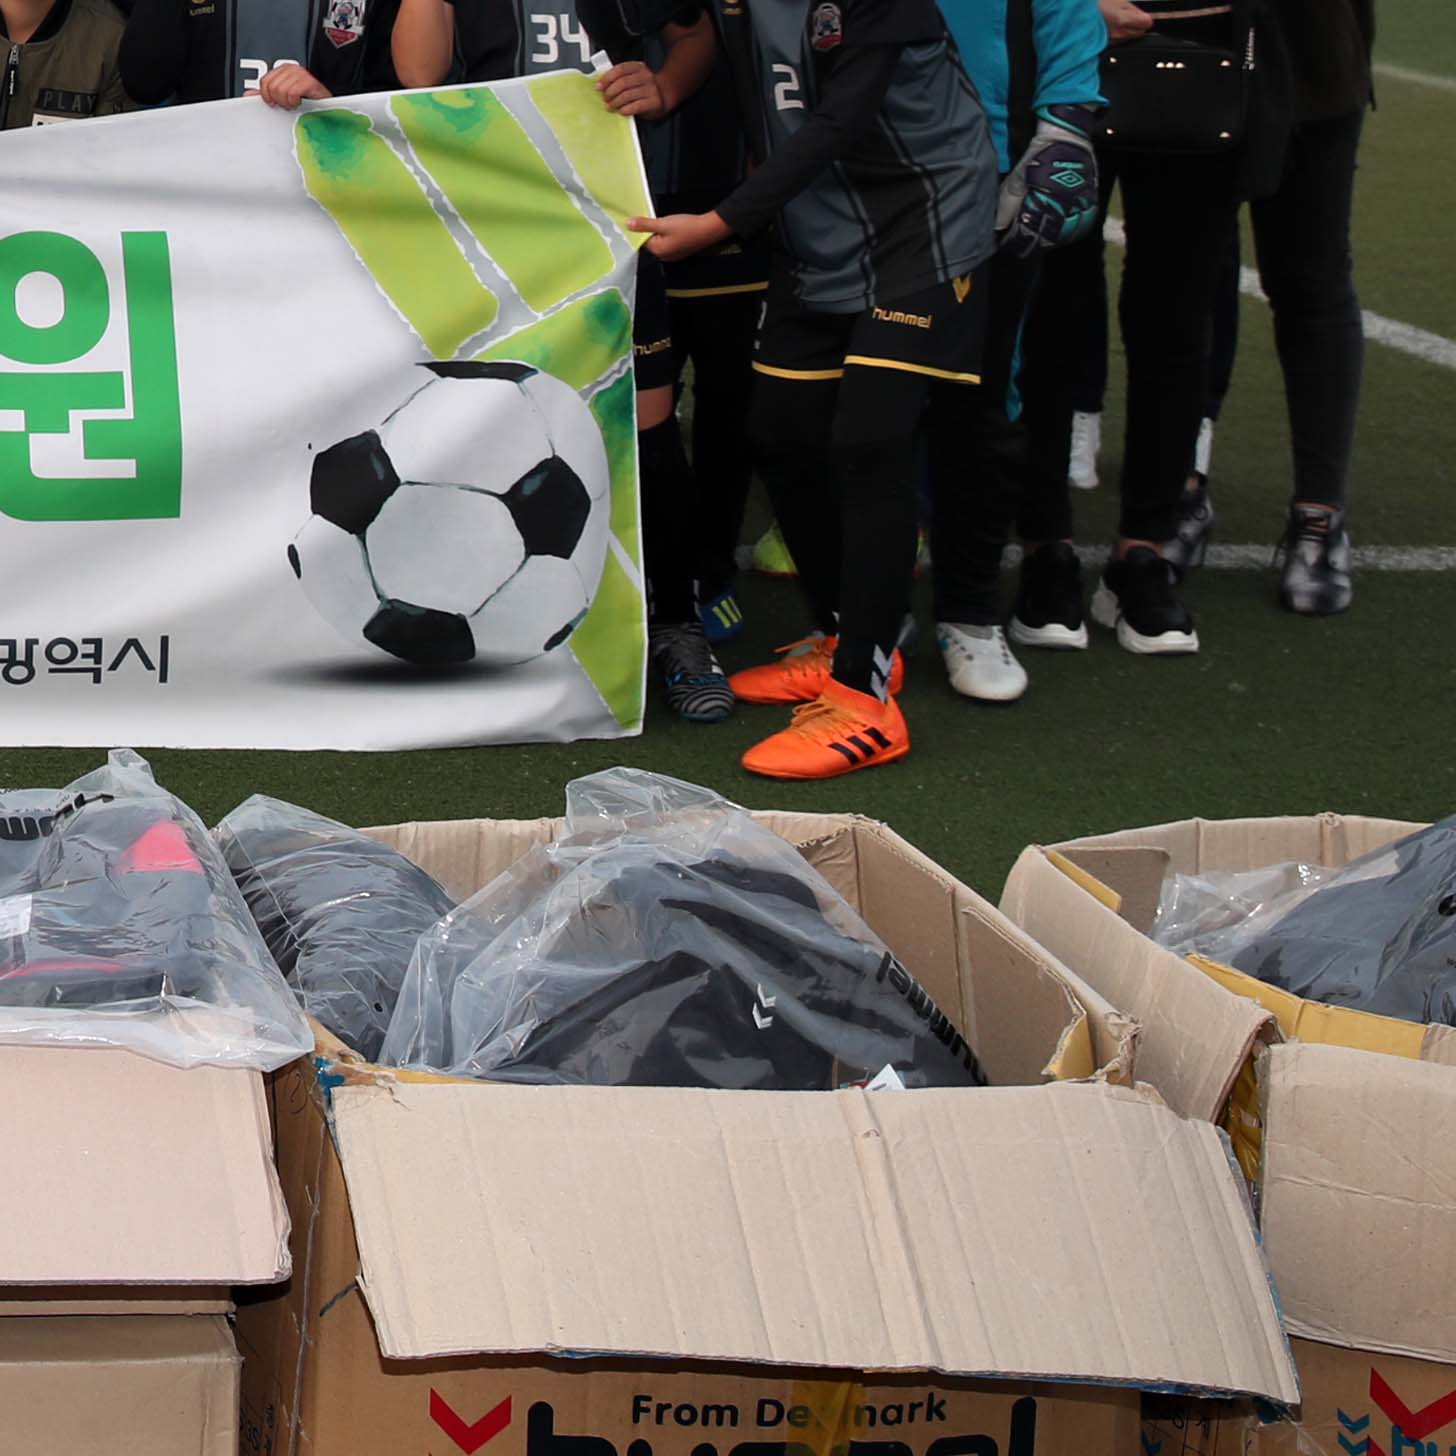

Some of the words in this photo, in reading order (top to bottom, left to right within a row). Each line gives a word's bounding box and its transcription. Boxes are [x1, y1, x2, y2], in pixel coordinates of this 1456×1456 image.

[531, 13, 591, 66] 34
[43, 94, 97, 114] PLAY
[772, 63, 805, 111] 2
[872, 306, 933, 329] hummel
[631, 1394, 739, 1428] From
[756, 1392, 947, 1428] Demark
